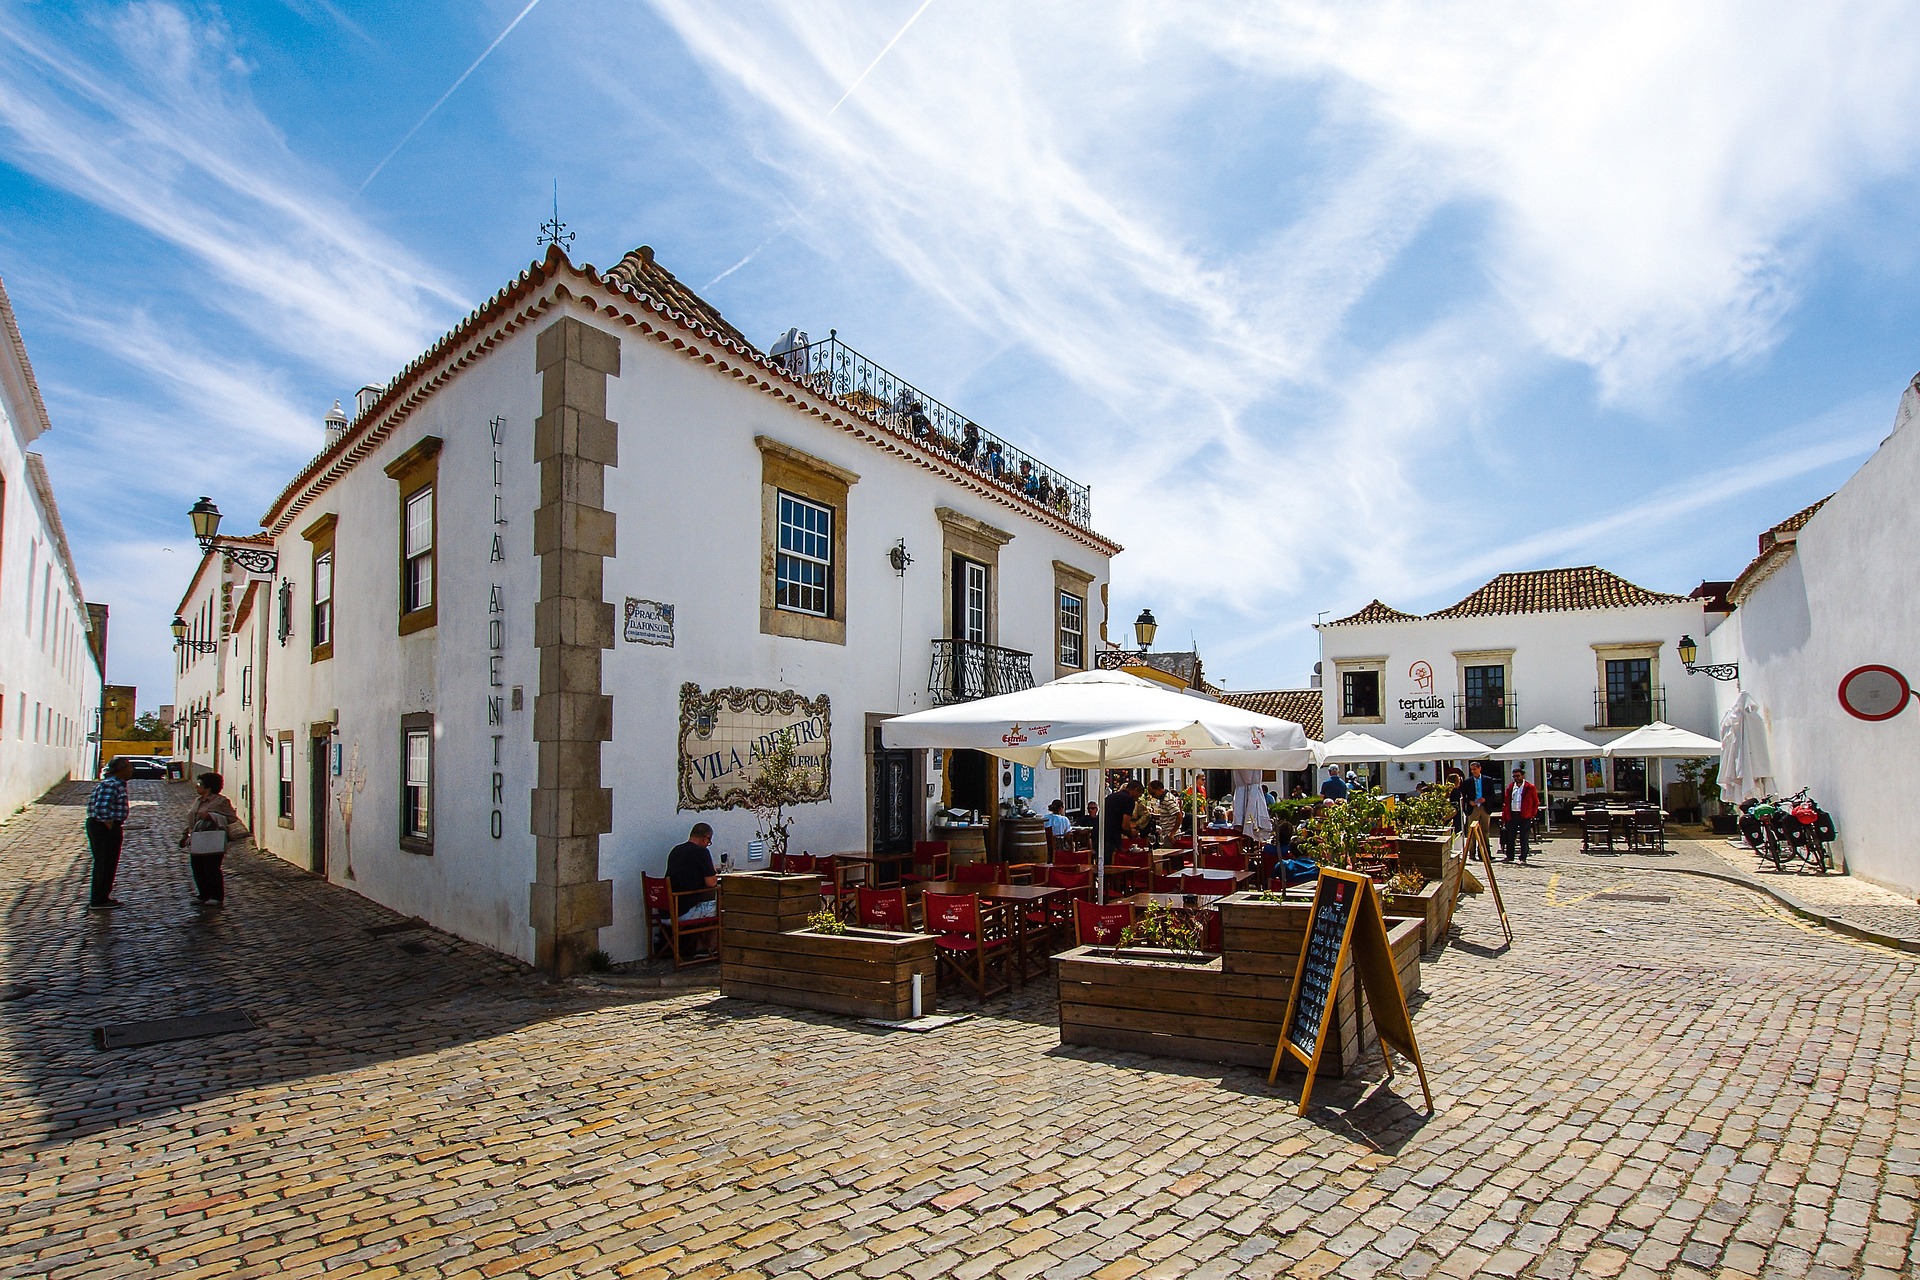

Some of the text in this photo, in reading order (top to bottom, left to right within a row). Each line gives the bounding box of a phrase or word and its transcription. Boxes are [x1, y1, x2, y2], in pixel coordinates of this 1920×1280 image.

[487, 415, 507, 840] VILA ADENTRO
[1398, 695, 1446, 710] tertúlia
[1404, 709, 1440, 721] algarvia
[1001, 733, 1028, 743] Estrella
[691, 746, 745, 783] VILA
[1151, 757, 1175, 765] Estrella
